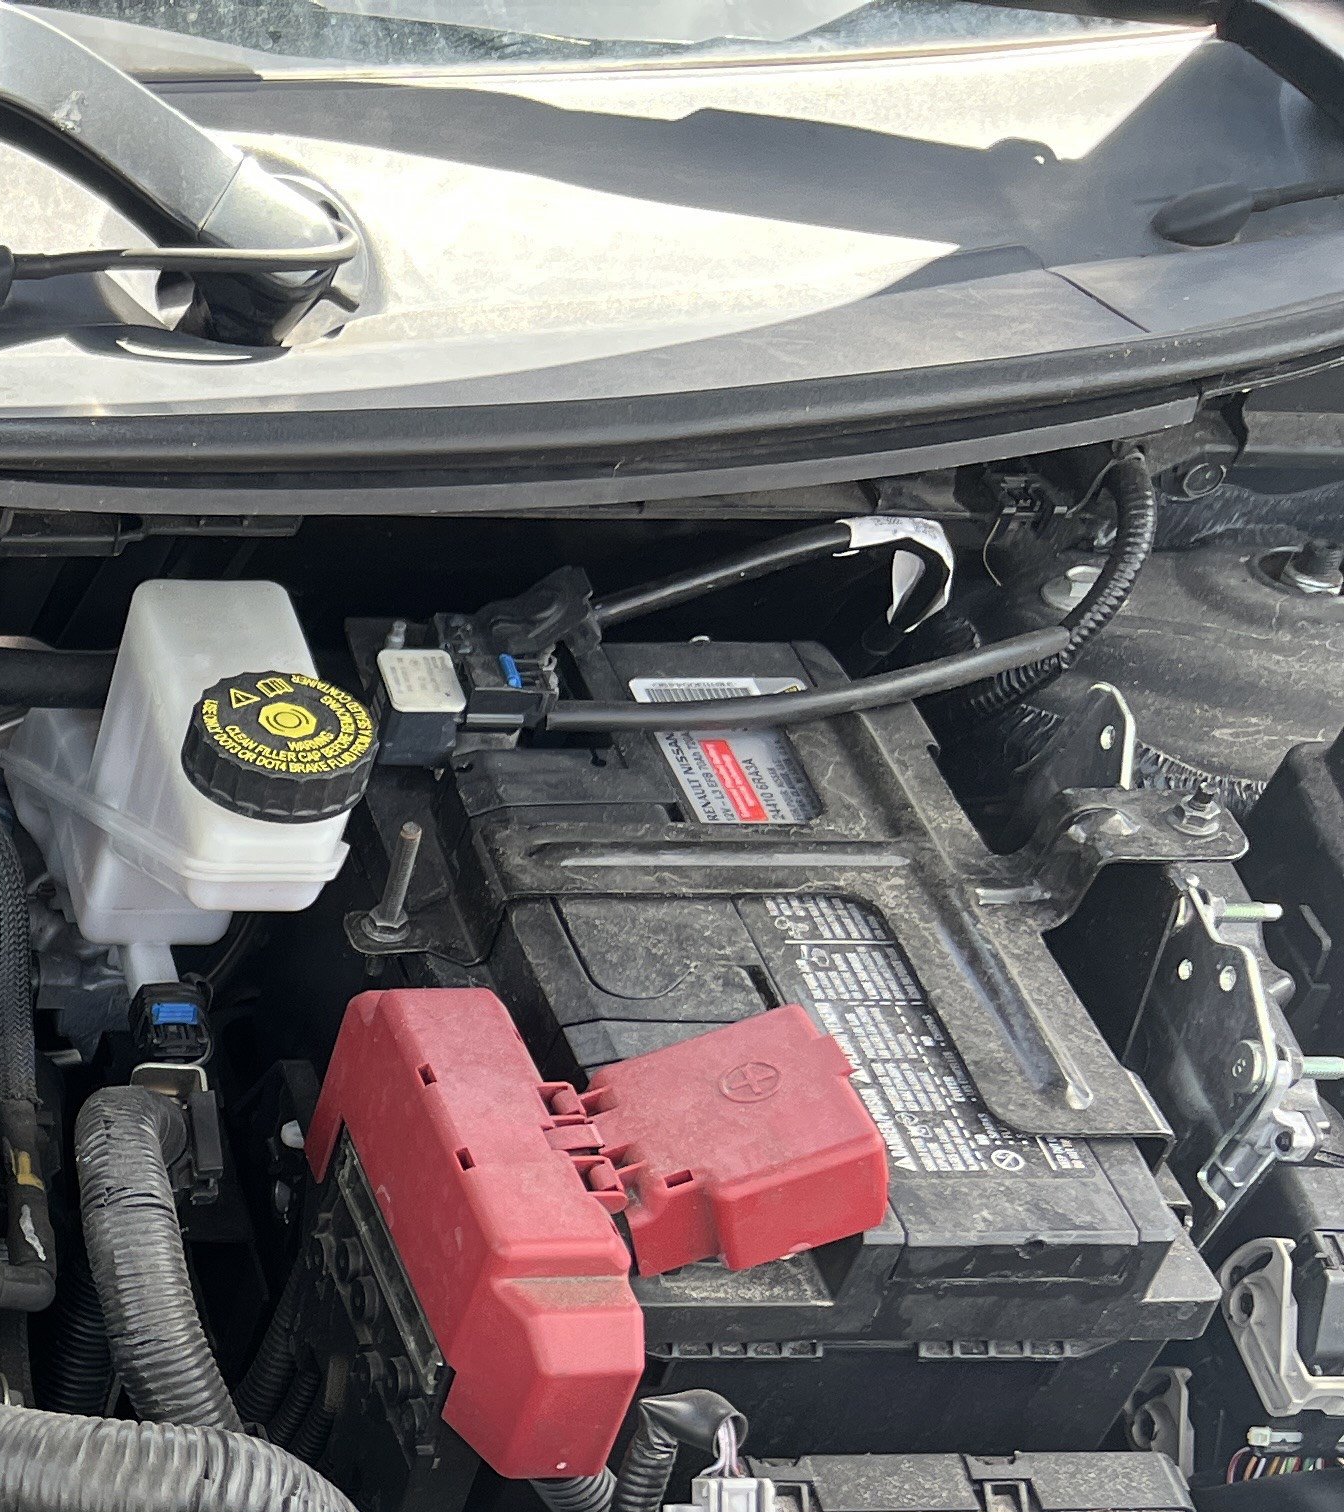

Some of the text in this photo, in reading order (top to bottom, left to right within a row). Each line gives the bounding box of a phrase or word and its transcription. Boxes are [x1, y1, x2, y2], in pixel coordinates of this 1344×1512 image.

[291, 674, 353, 704] CONTAINER
[225, 695, 355, 762] CLEAN FILLER CAP BEFORE REMOVING
[214, 732, 240, 754] DOT3
[287, 731, 335, 752] WARNING
[237, 750, 256, 763] OR
[255, 755, 287, 772] DOT4
[289, 760, 330, 774] BRAKE
[329, 752, 358, 771] FLUID
[685, 778, 720, 821] RENAULT
